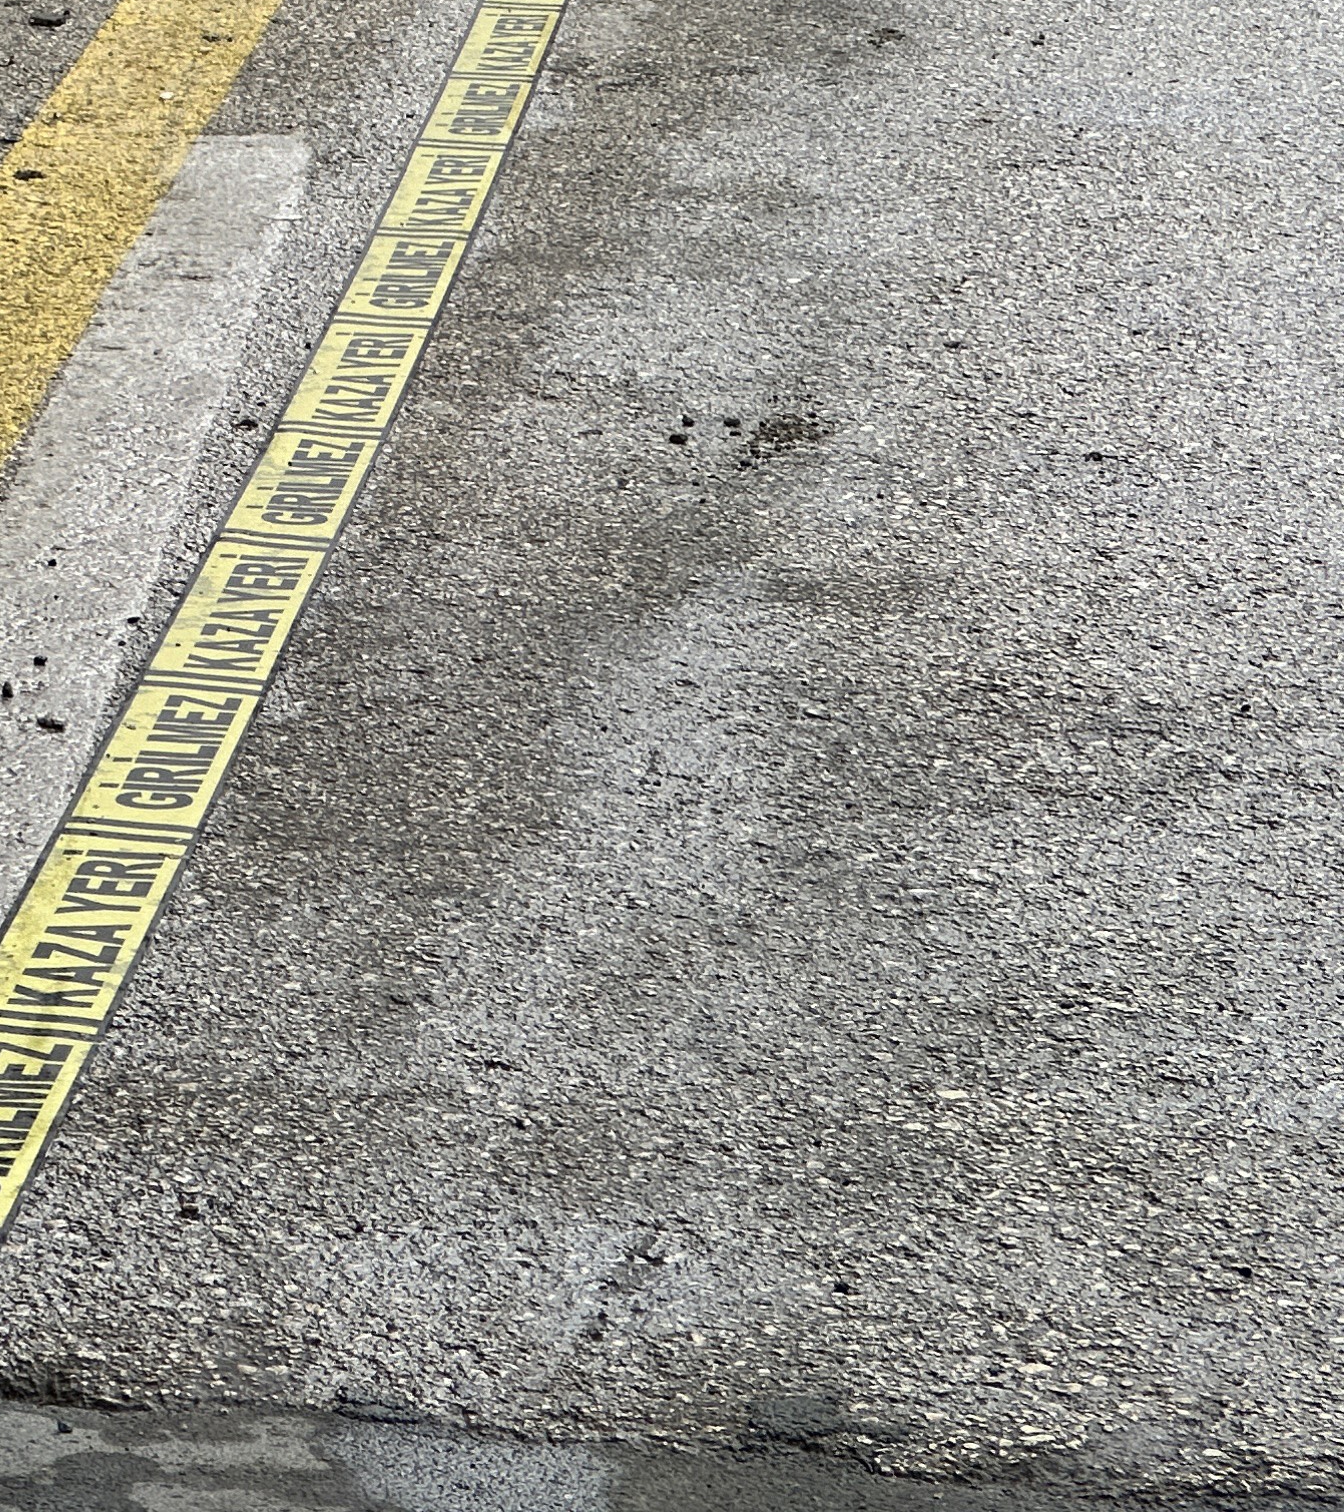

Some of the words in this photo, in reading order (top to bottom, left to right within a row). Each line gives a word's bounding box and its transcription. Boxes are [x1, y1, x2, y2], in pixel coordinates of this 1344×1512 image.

[421, 152, 492, 188] YERİ
[406, 187, 478, 228] KAZA
[354, 240, 456, 310] GİRİLMEZ
[334, 331, 413, 373] YERİ
[312, 373, 394, 424] KAZA
[247, 437, 366, 527] GİRİLMEZ
[217, 553, 310, 608] YERİ
[183, 609, 287, 673] KAZA
[98, 693, 243, 811] GİRİLMEZ
[54, 848, 168, 915] YERİ
[7, 923, 131, 1010] KAZA
